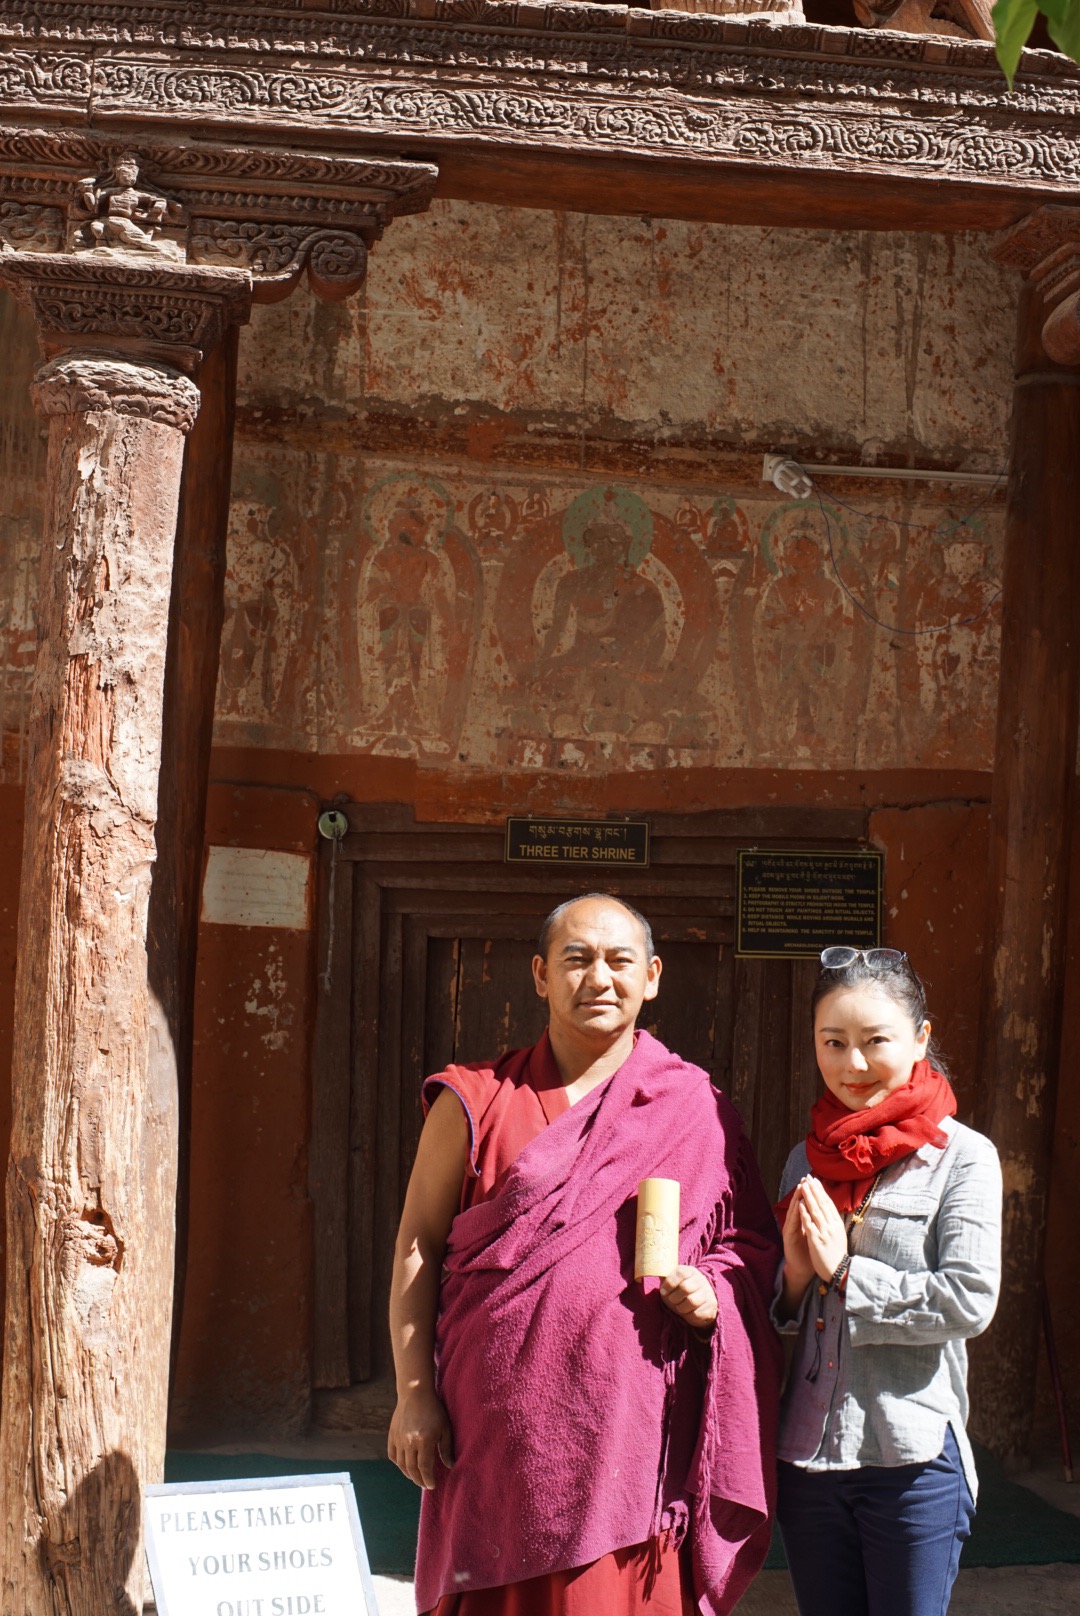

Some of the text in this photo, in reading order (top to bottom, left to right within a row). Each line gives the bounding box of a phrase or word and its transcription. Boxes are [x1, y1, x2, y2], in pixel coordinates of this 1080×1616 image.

[520, 845, 635, 859] THREE TIER SHRINE
[160, 1502, 337, 1532] PLEASE TAKE OFF
[188, 1547, 333, 1576] YOUR SHOES
[217, 1594, 326, 1616] OUT SIDE
